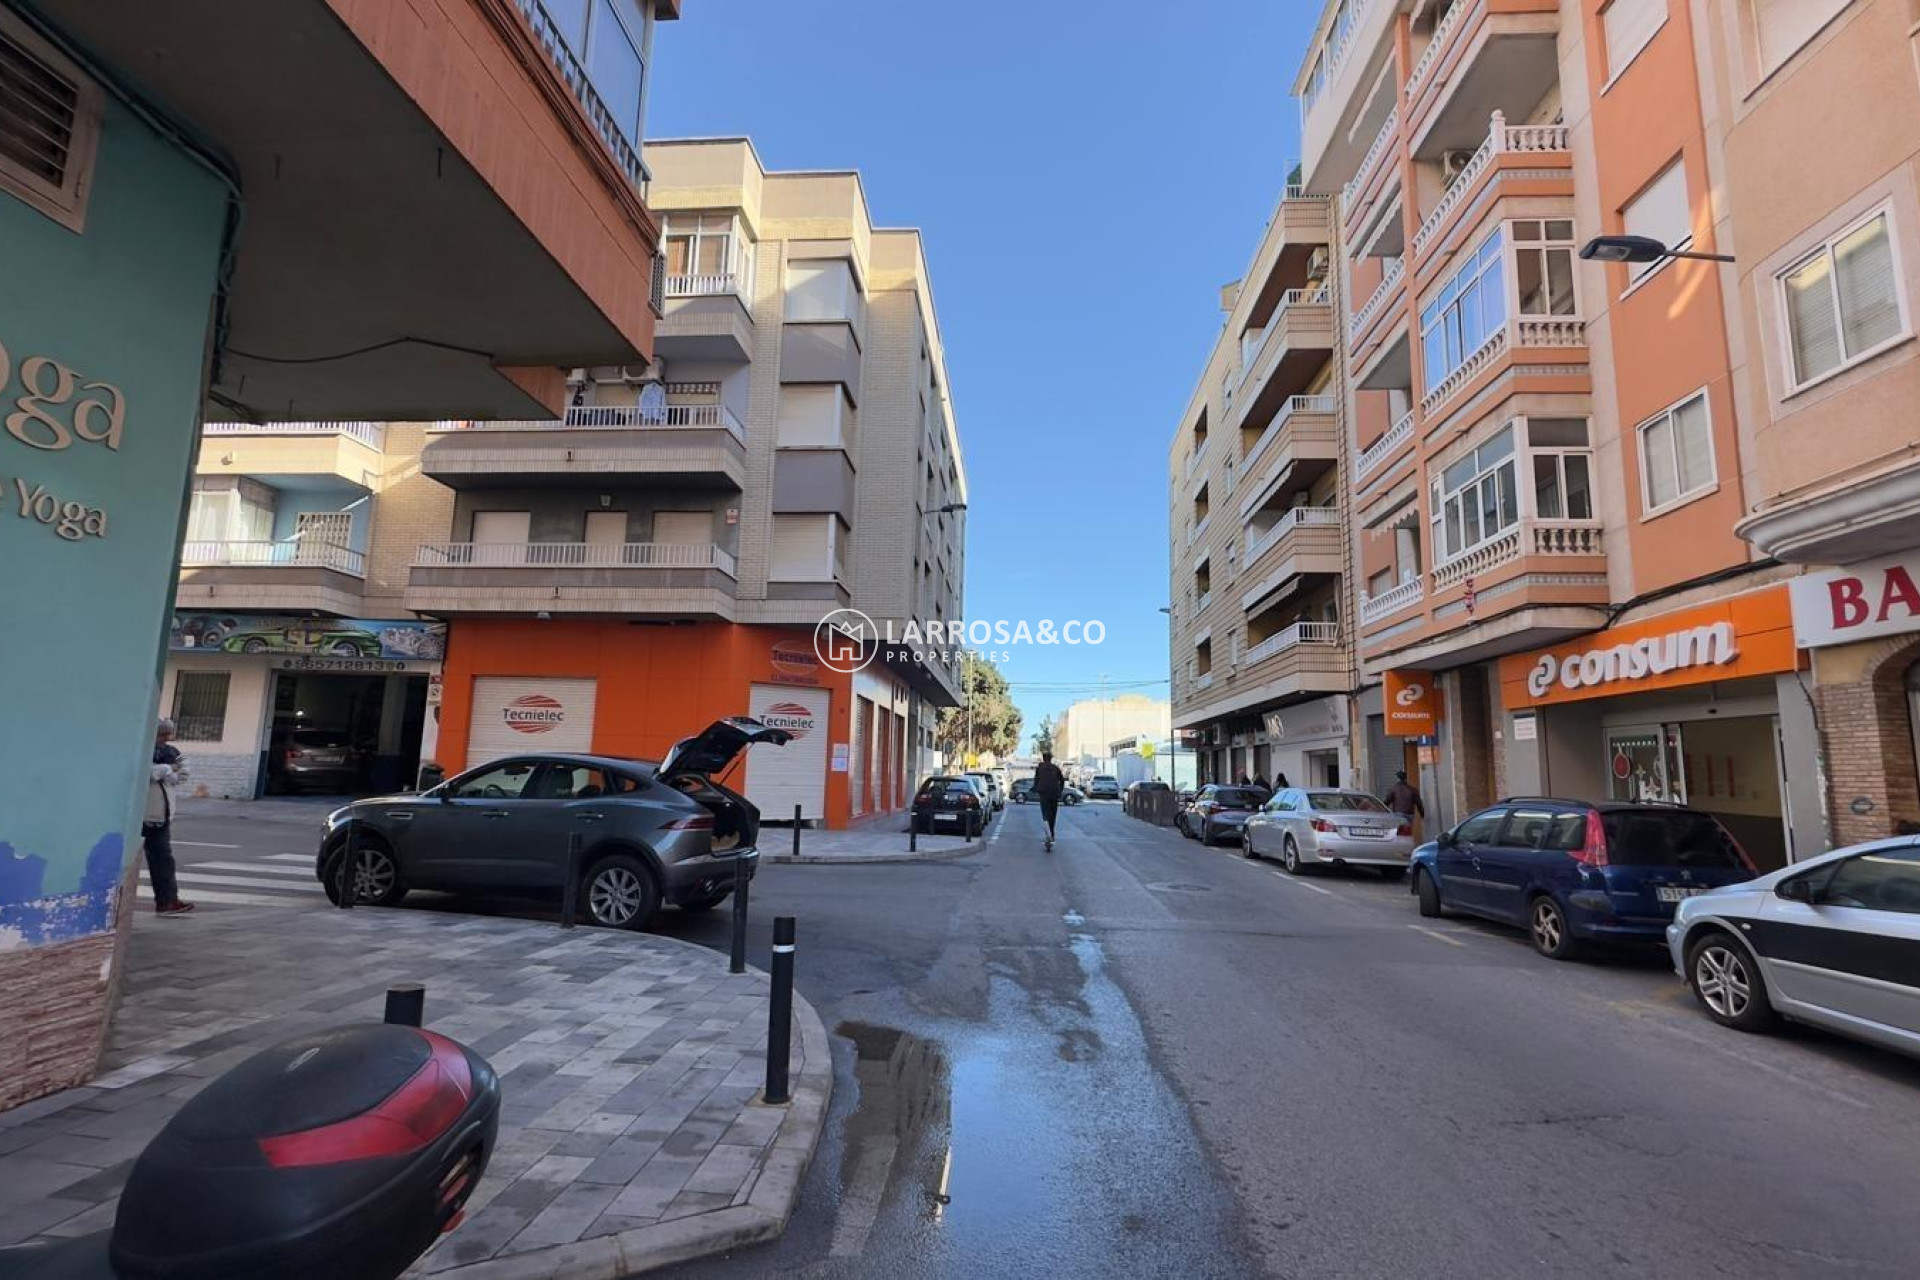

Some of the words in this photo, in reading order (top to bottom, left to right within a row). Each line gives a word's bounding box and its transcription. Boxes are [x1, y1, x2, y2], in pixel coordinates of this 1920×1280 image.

[0, 341, 126, 452] ga
[15, 478, 107, 540] Yoga
[1826, 565, 1920, 630] BA
[1560, 621, 1738, 689] consum
[503, 707, 565, 721] Tecnielec
[759, 715, 815, 729] Tecnielec
